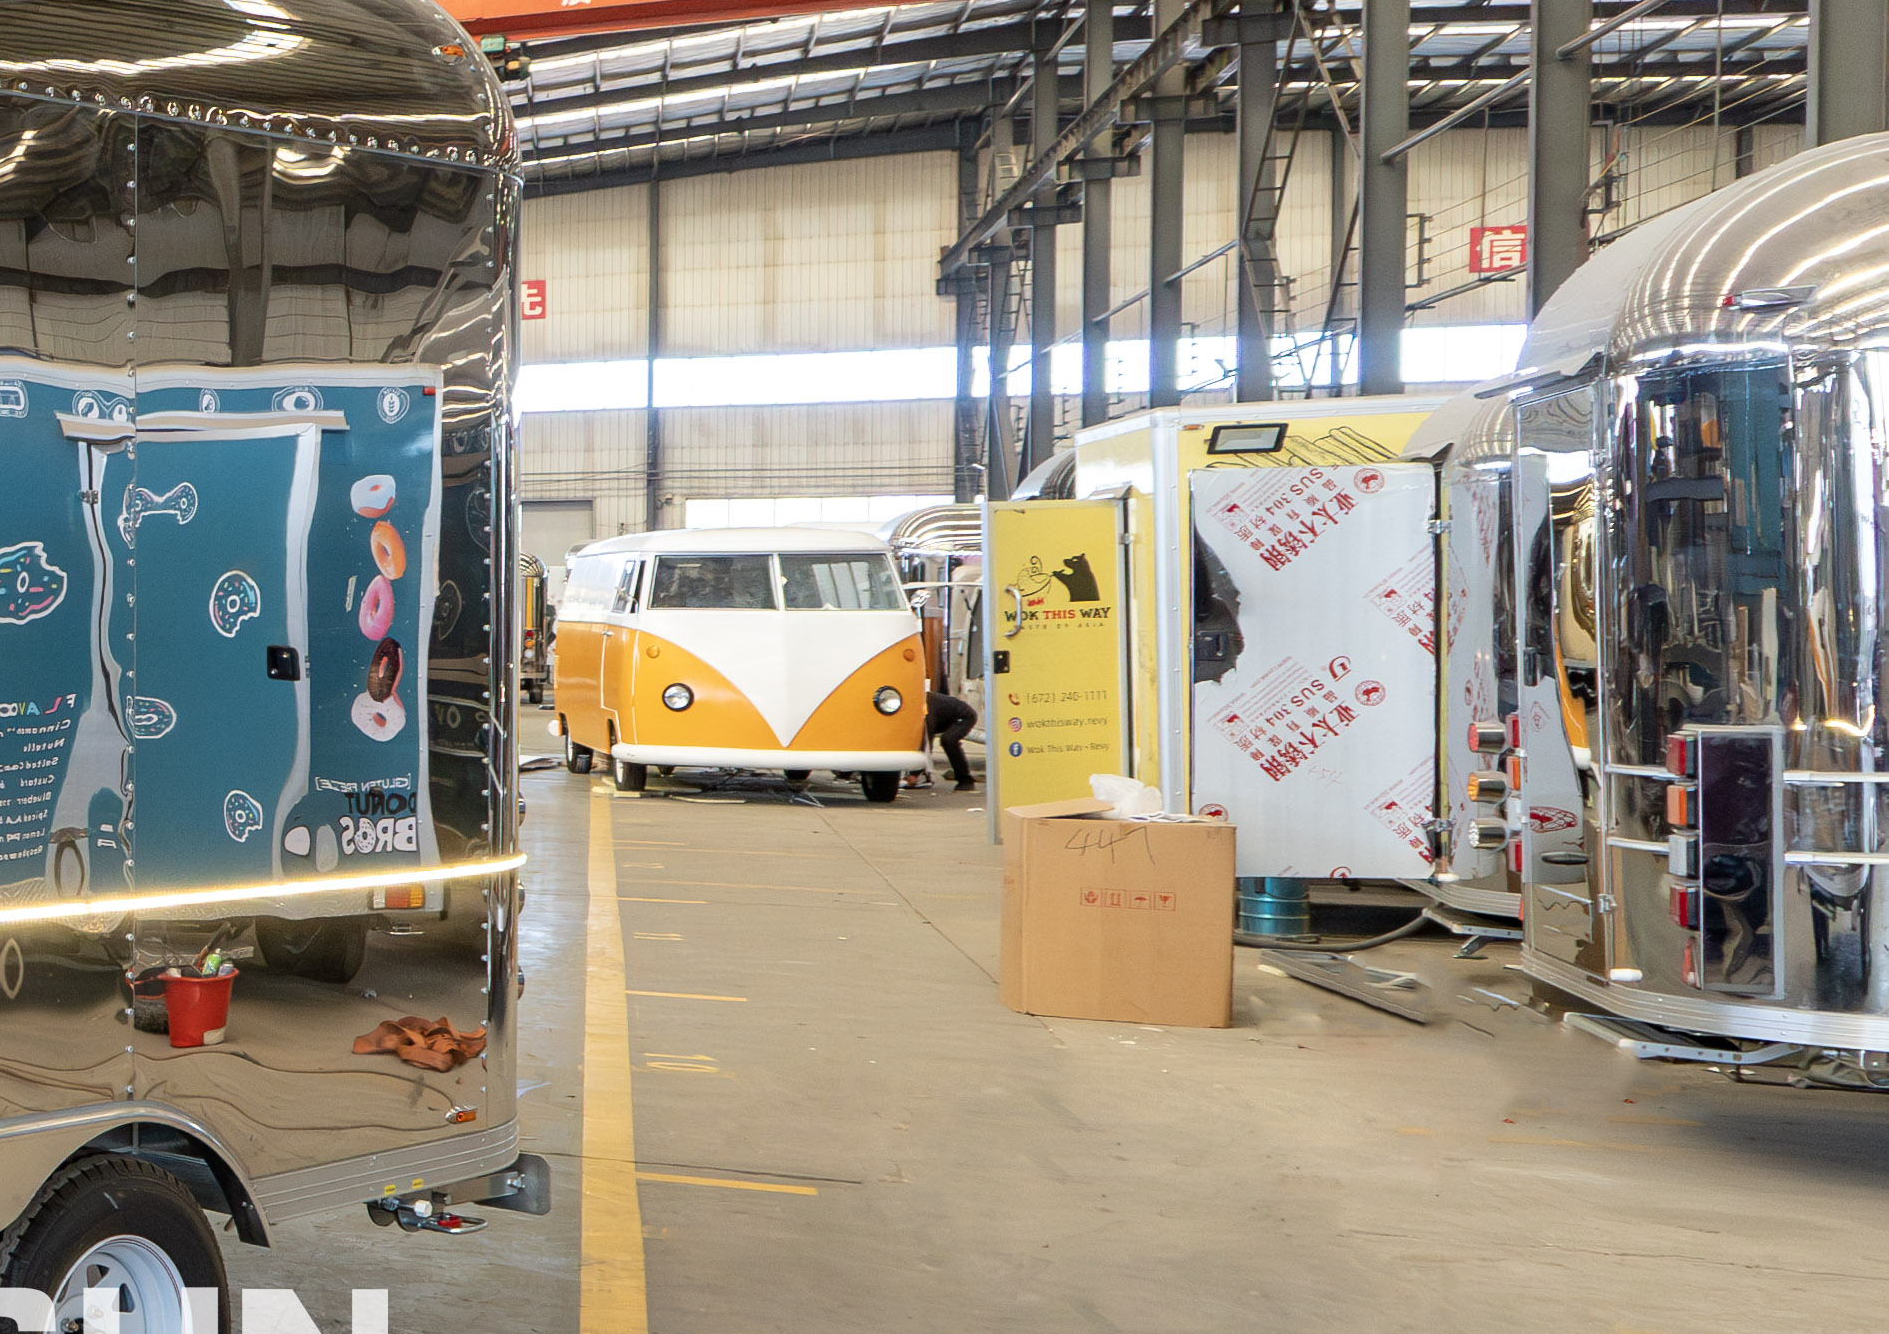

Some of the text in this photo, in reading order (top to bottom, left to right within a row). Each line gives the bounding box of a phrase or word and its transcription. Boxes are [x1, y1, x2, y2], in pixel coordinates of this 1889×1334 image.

[1476, 229, 1526, 269] 信
[1042, 609, 1076, 620] THIS
[1079, 607, 1111, 619] WAY
[1290, 679, 1325, 707] SUS
[1265, 703, 1292, 727] 304
[1259, 700, 1360, 782] 亚太不锈钢
